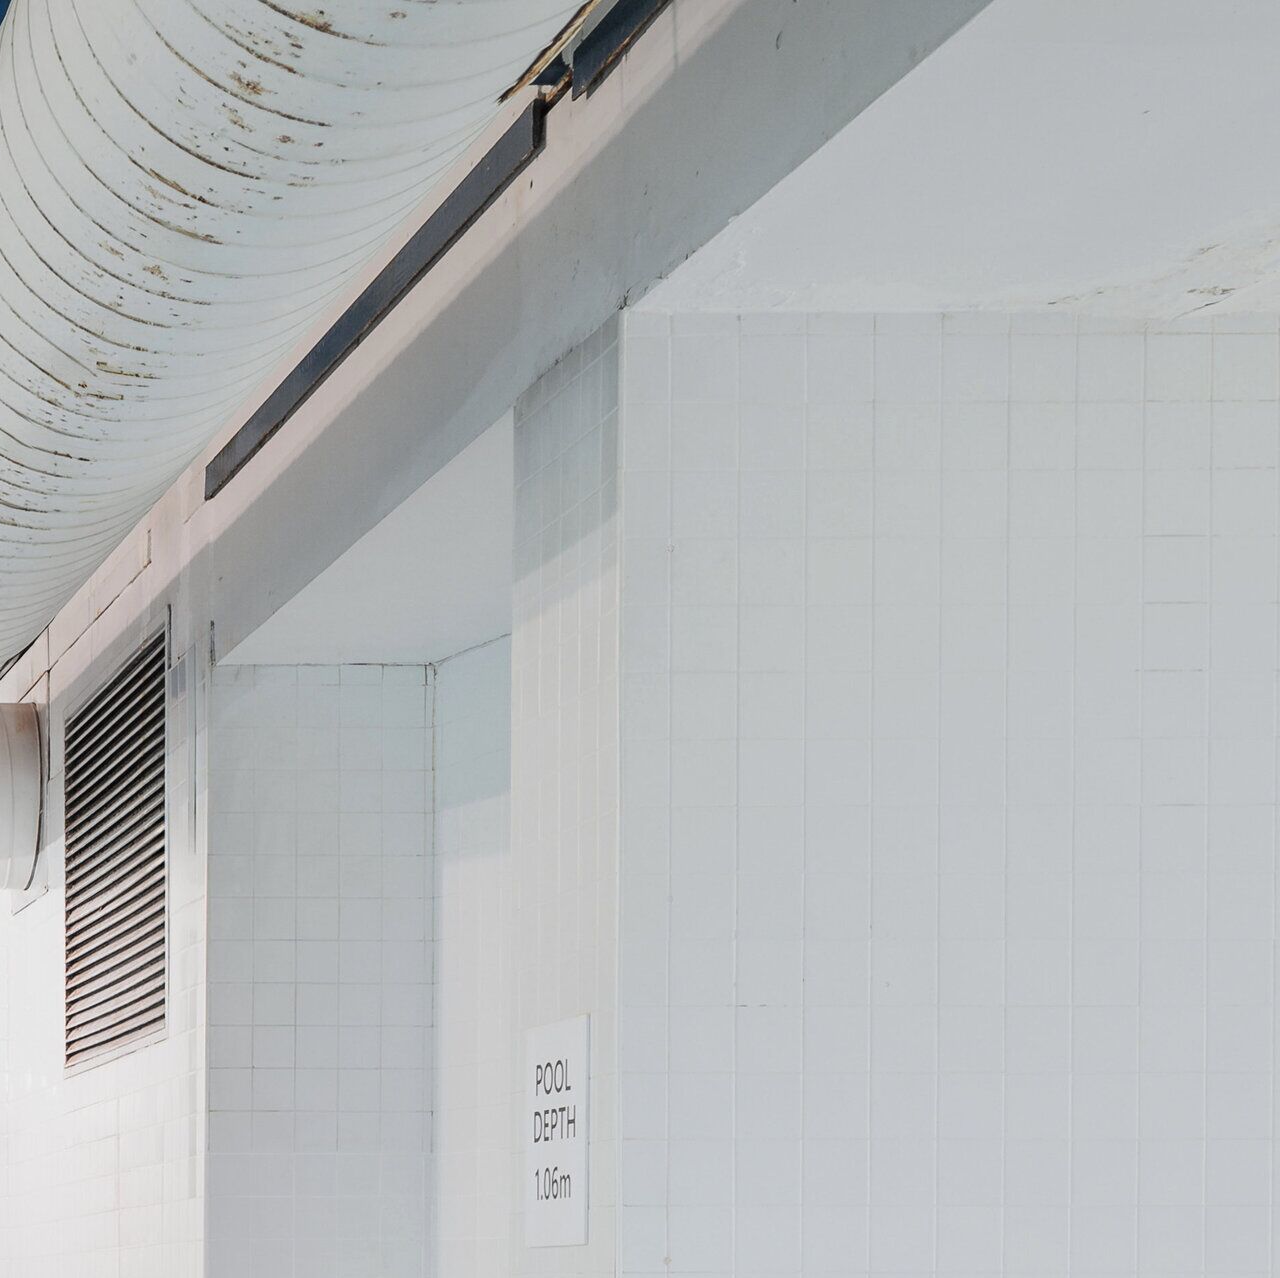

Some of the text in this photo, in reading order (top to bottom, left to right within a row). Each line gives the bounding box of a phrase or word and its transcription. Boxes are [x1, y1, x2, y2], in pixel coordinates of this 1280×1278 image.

[536, 1059, 571, 1096] POOL
[534, 1105, 576, 1143] DEPTH
[535, 1166, 571, 1200] 1.06m
